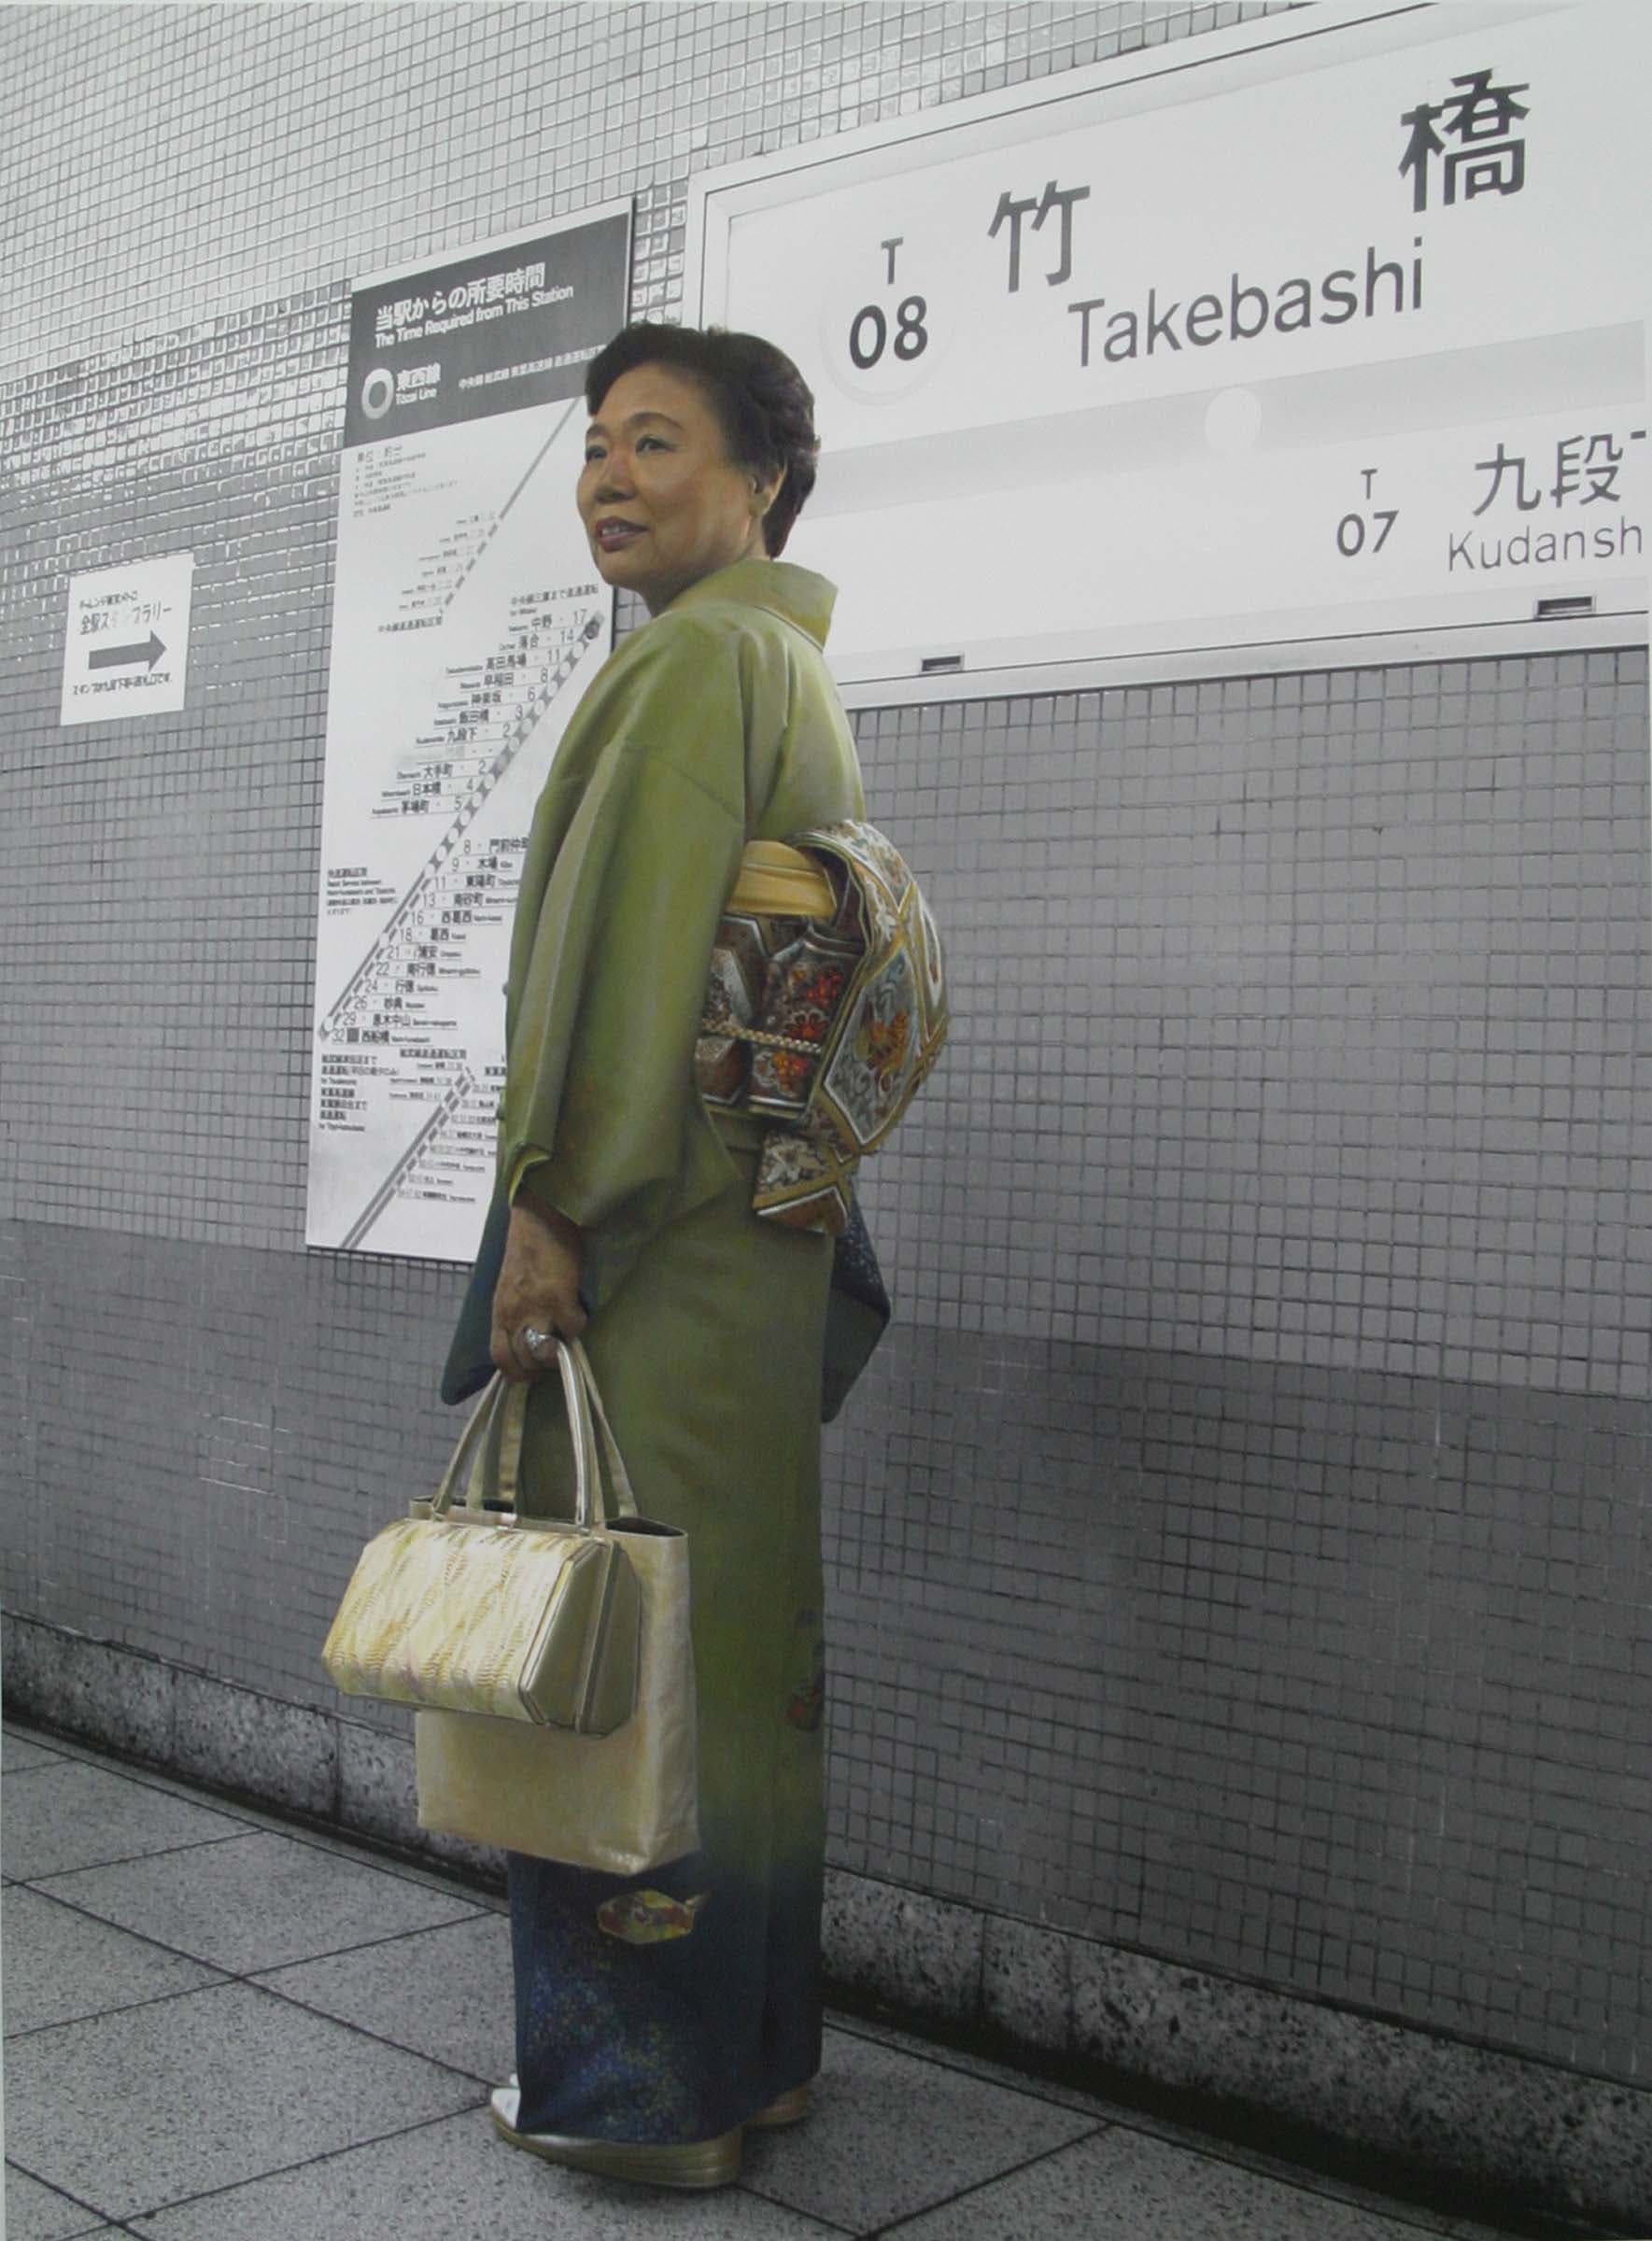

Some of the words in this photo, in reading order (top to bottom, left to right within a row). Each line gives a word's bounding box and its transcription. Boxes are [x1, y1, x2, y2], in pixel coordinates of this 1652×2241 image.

[881, 236, 904, 286] T
[374, 332, 395, 349] The
[396, 327, 423, 343] Time
[425, 310, 475, 334] Required
[476, 304, 504, 322] from
[505, 295, 529, 315] This
[531, 284, 574, 307] Station
[375, 261, 546, 331] 当駅からの所要時間
[1066, 235, 1425, 367] Takebashi
[849, 294, 929, 371] 08
[1360, 469, 1377, 500] T
[1336, 509, 1400, 557] 07
[1448, 515, 1642, 572] Kudansh
